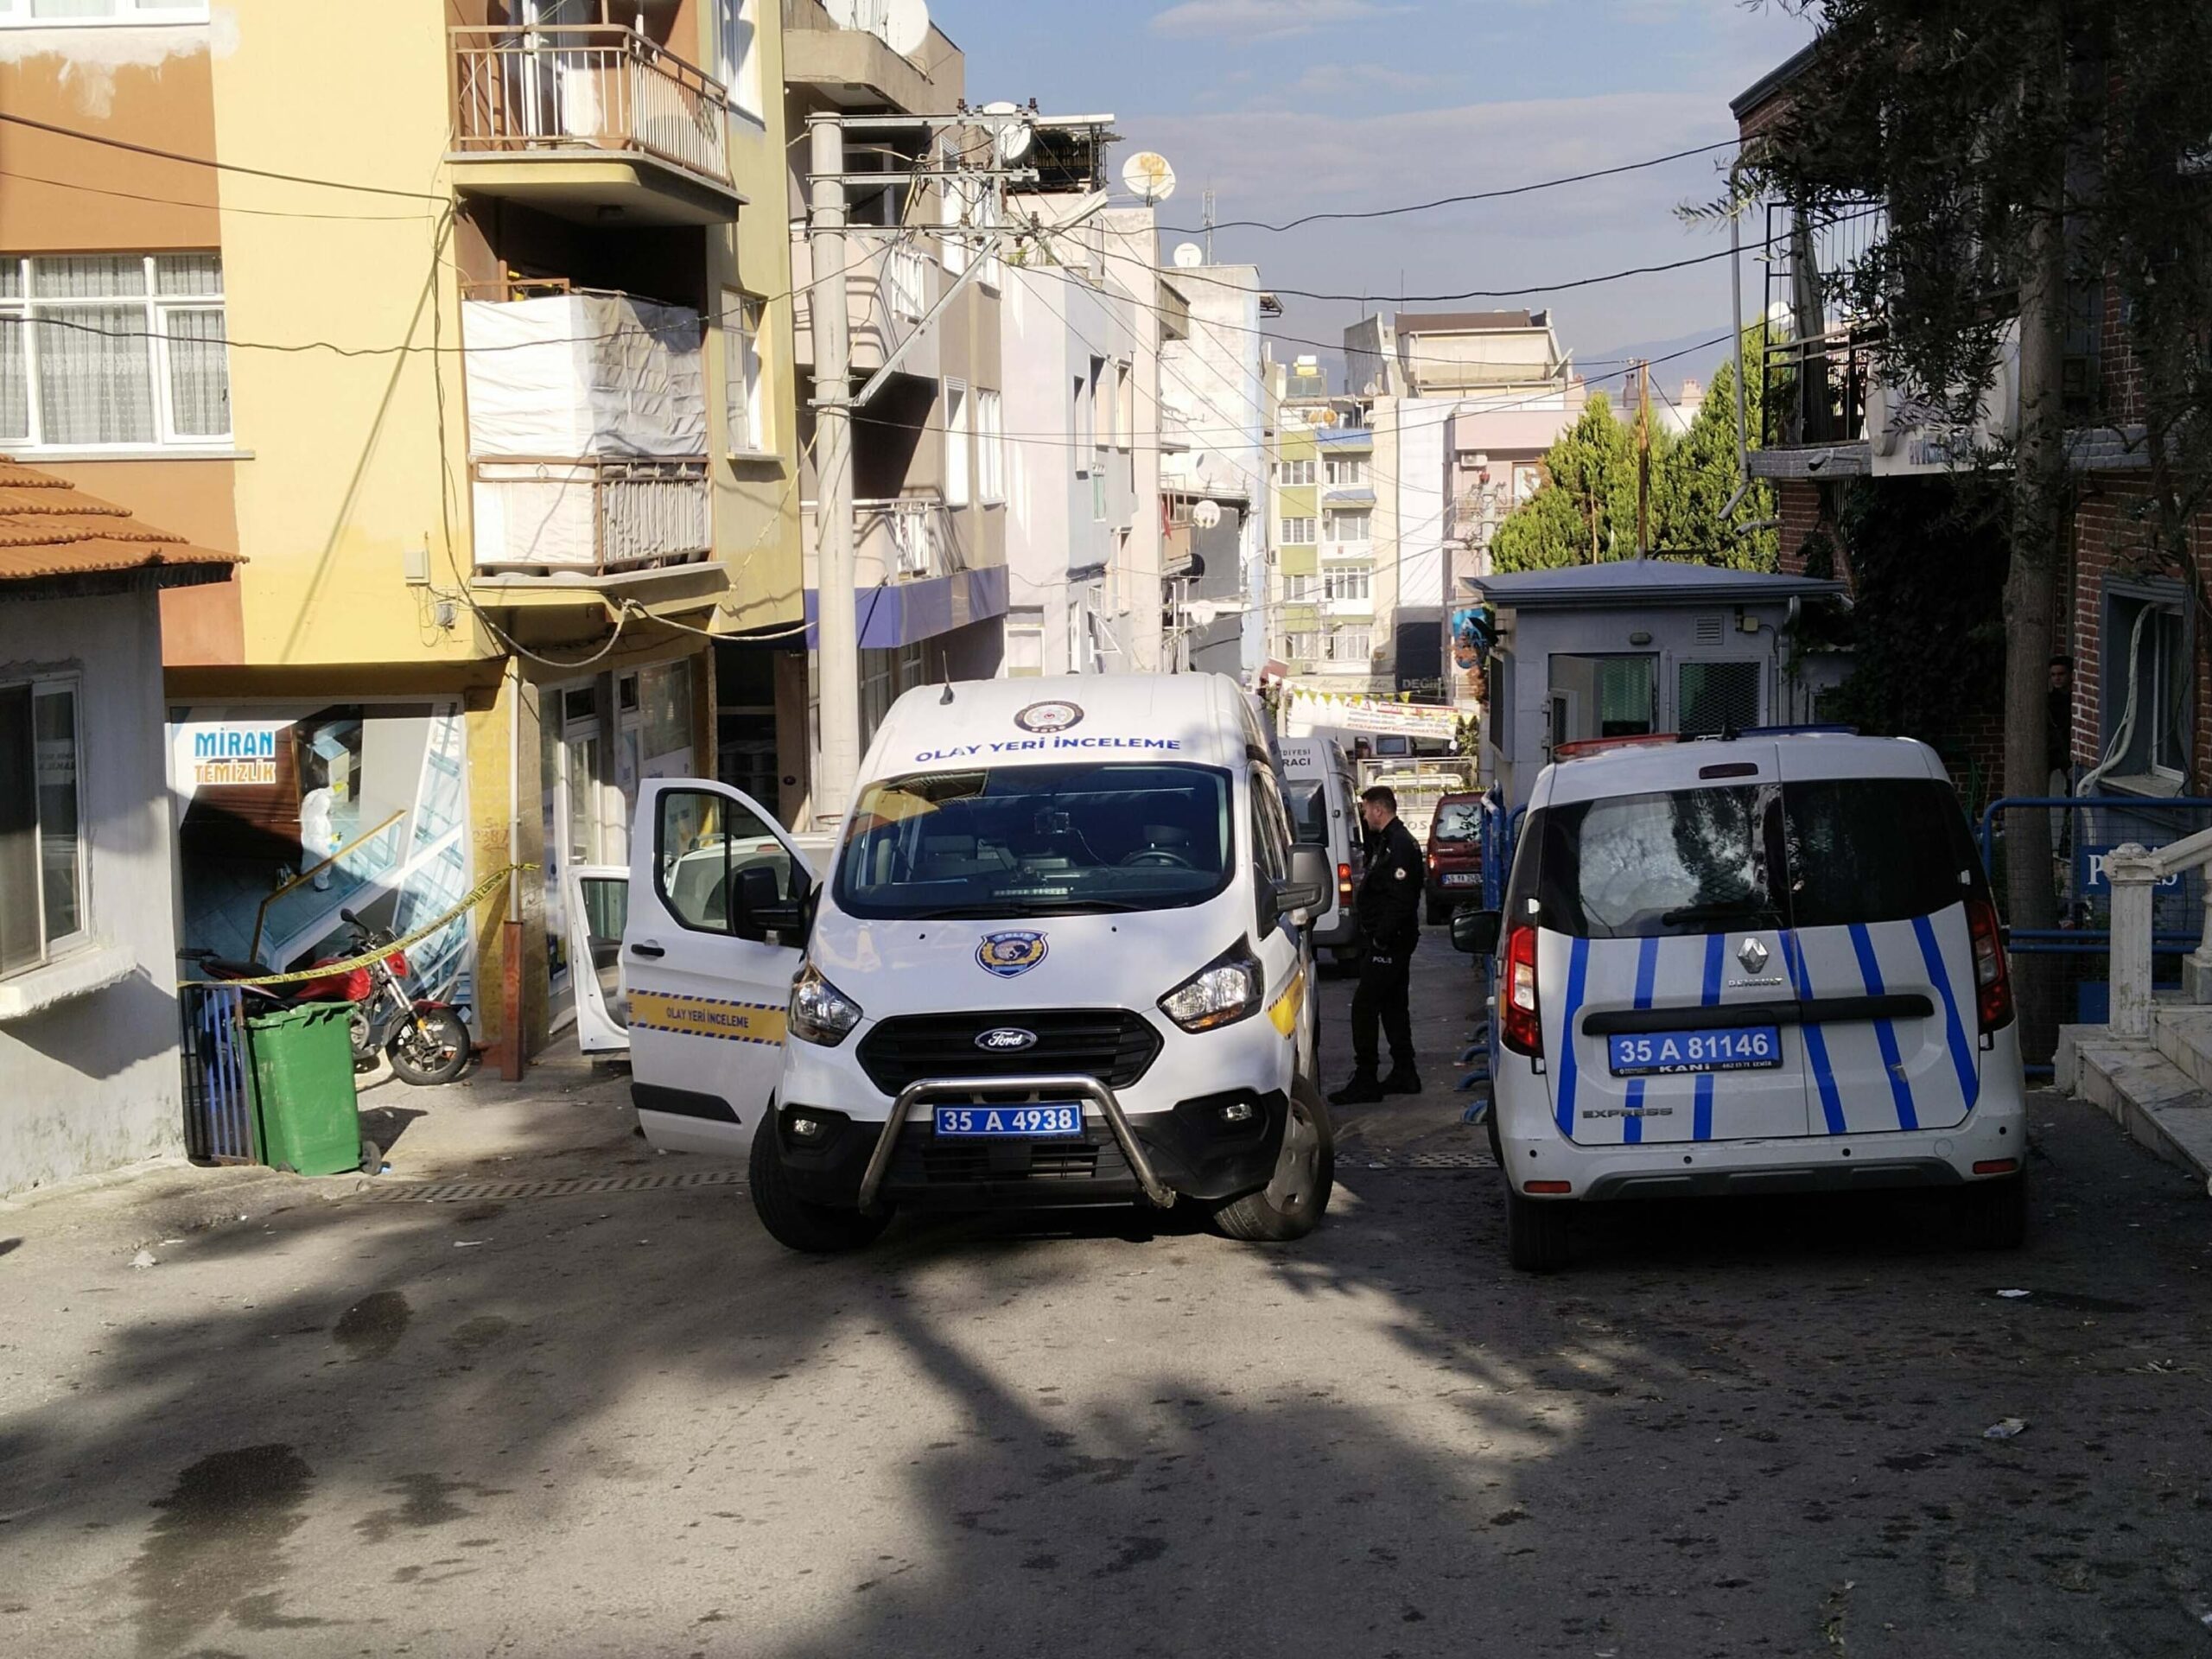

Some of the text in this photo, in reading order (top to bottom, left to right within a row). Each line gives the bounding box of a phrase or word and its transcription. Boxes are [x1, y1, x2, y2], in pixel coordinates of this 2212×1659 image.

[194, 727, 273, 757] MİRAN
[915, 735, 1180, 762] OLAY YERİ İNCELEME
[194, 760, 274, 783] TEMİZLİK
[1281, 758, 1311, 767] RACI
[666, 1007, 749, 1028] OLAY YERİ İNCELEME
[988, 1031, 1023, 1046] Ford
[1620, 1033, 1769, 1063] 35 A 81146
[944, 1109, 1072, 1131] 35 A 4938
[1583, 1108, 1673, 1119] EXPRESS
